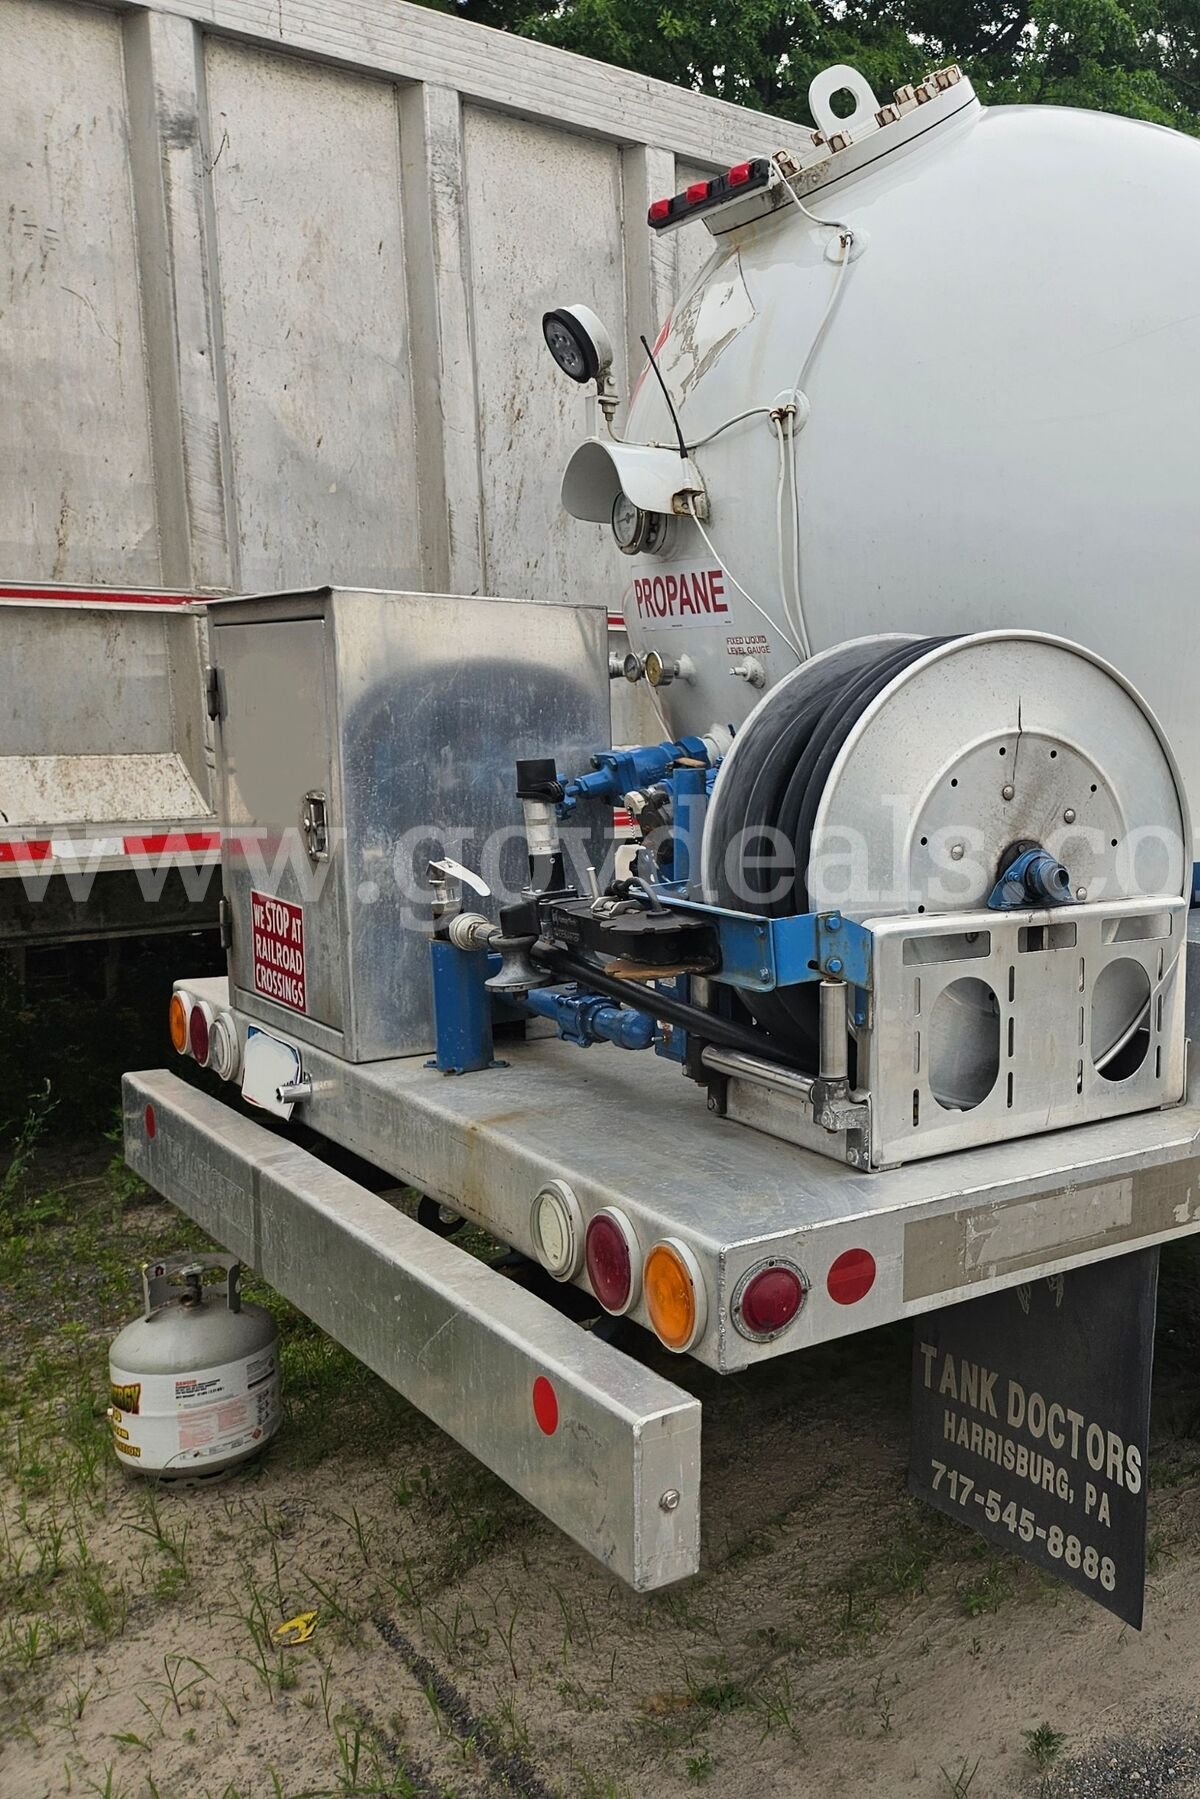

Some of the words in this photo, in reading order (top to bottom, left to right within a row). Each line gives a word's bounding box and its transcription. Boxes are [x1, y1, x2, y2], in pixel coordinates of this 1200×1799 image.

[634, 570, 728, 619] PROPANE
[726, 636, 744, 645] FIXED
[745, 635, 767, 644] LIQUID
[727, 646, 746, 655] LEVEL
[747, 646, 771, 654] GAUGE
[253, 903, 265, 929] WE
[265, 901, 289, 938] STOP
[291, 917, 302, 944] AT
[255, 933, 303, 975] RAILROAD
[255, 963, 304, 1007] CROSSINGS
[920, 1342, 999, 1419] TANK
[1007, 1380, 1142, 1494] DOCTORS
[944, 1409, 1074, 1504] HARRISBURG,
[1085, 1482, 1111, 1528] PA
[931, 1459, 1116, 1591] 717-545-8888
